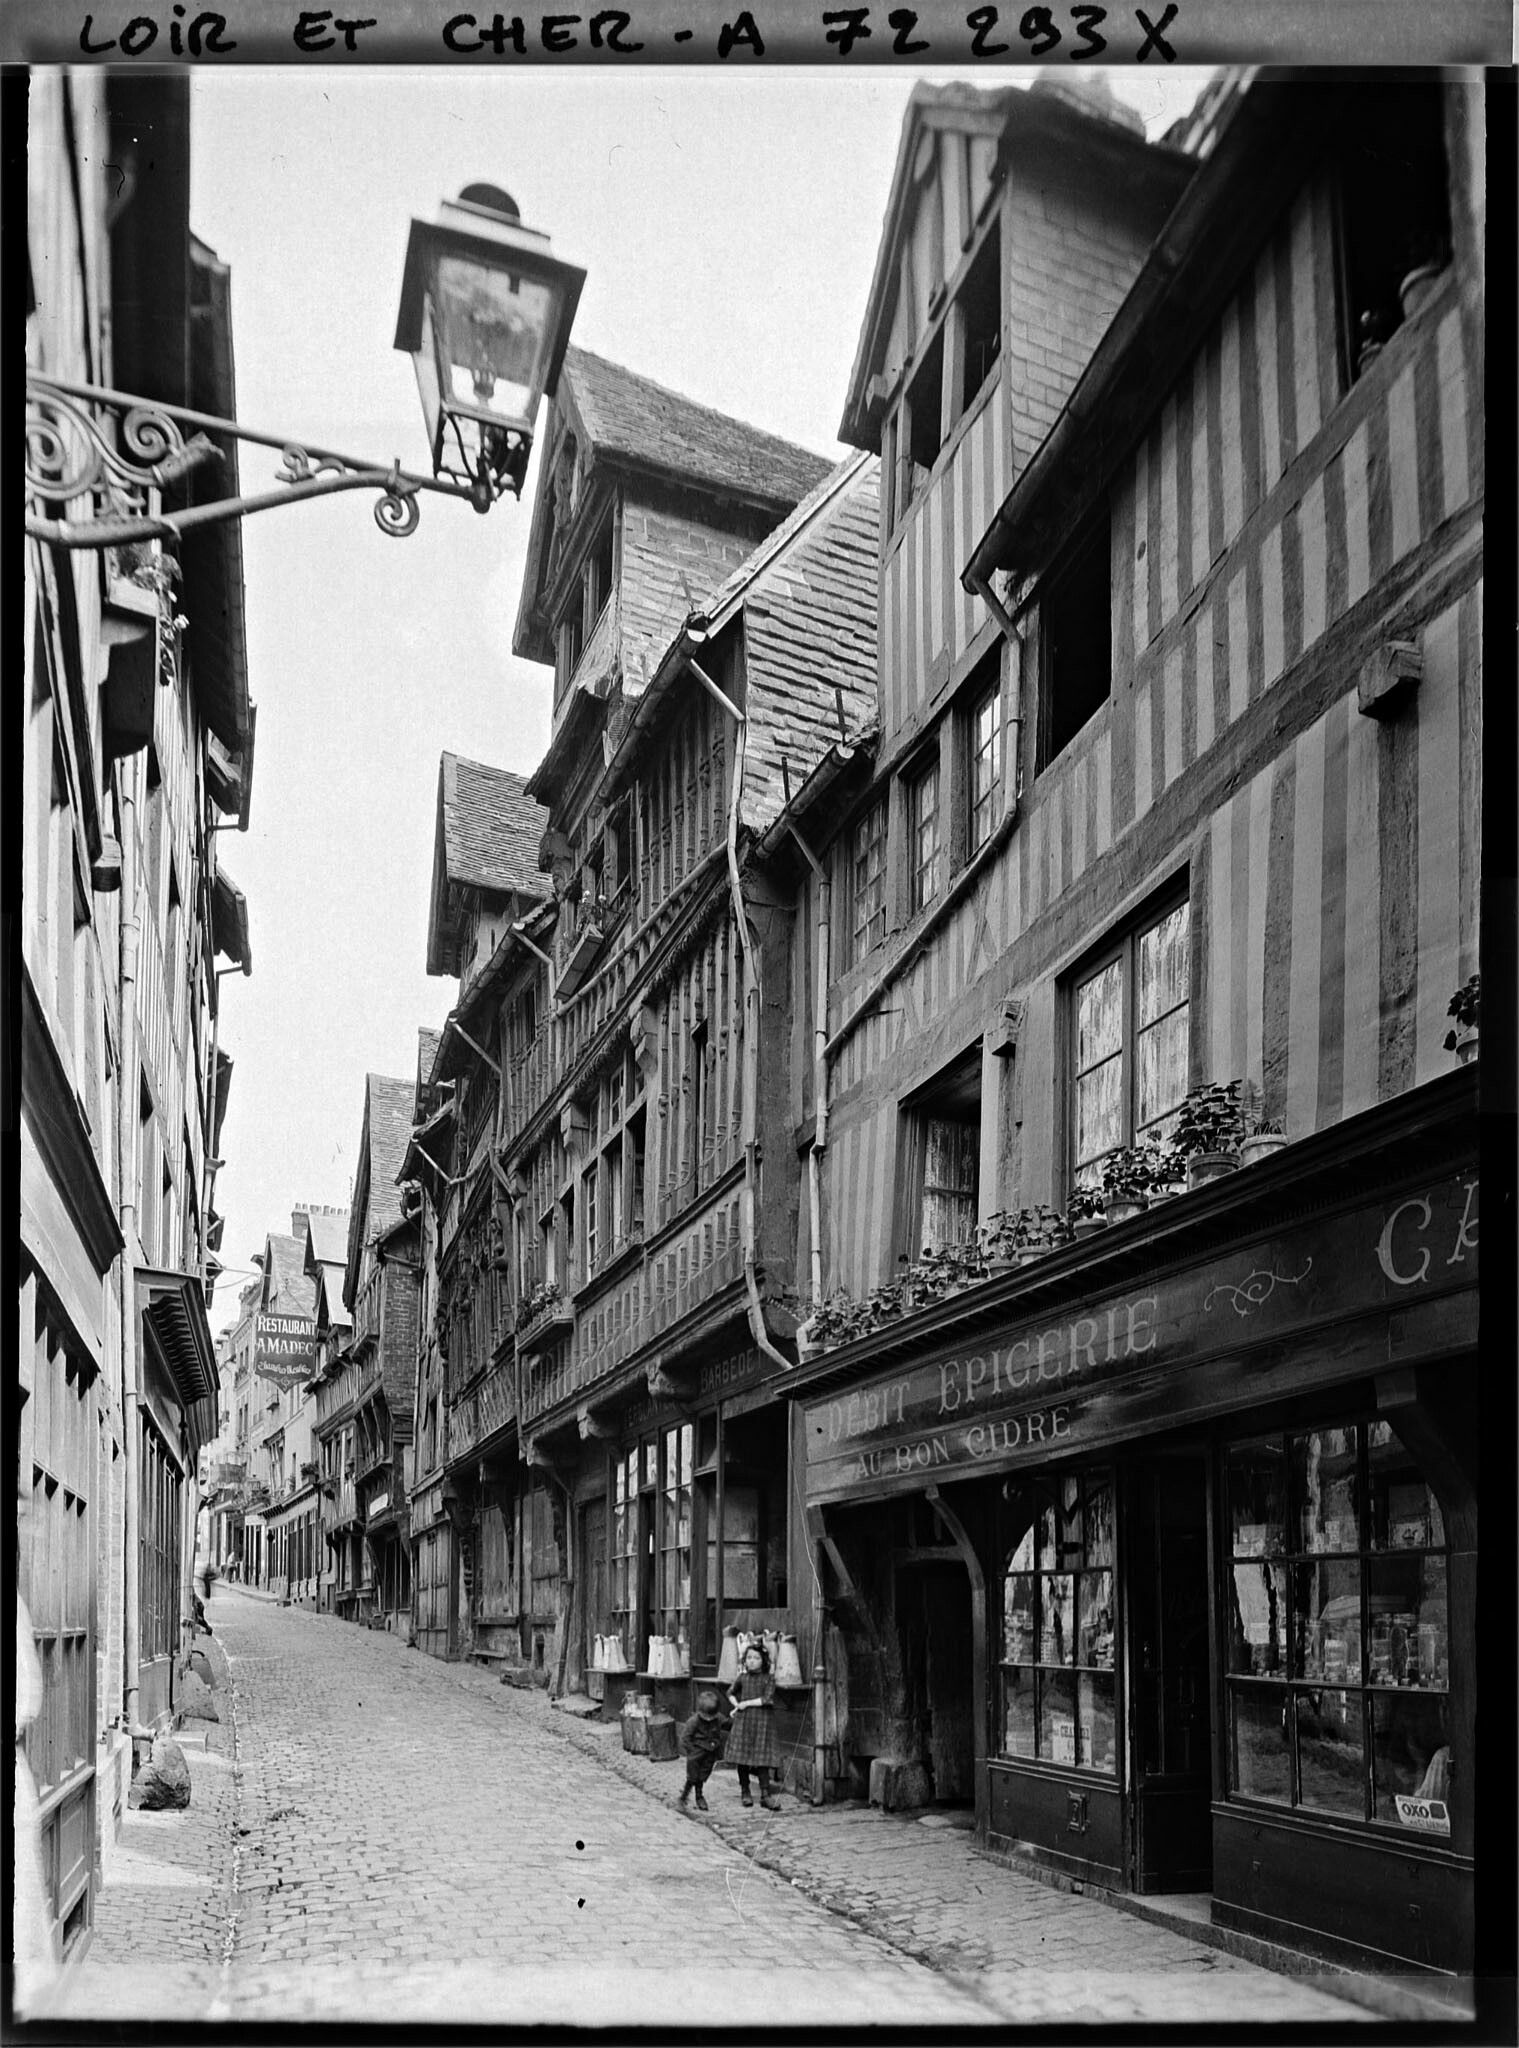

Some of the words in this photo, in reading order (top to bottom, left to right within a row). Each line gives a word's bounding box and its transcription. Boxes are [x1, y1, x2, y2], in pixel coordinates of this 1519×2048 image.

[257, 1314, 316, 1336] RESTAURANT
[938, 1296, 1158, 1415] EPICERIE
[857, 1452, 882, 1477] AU
[895, 1436, 950, 1473] BON
[965, 1406, 1072, 1458] CIDRE
[1401, 1803, 1429, 1819] OXO
